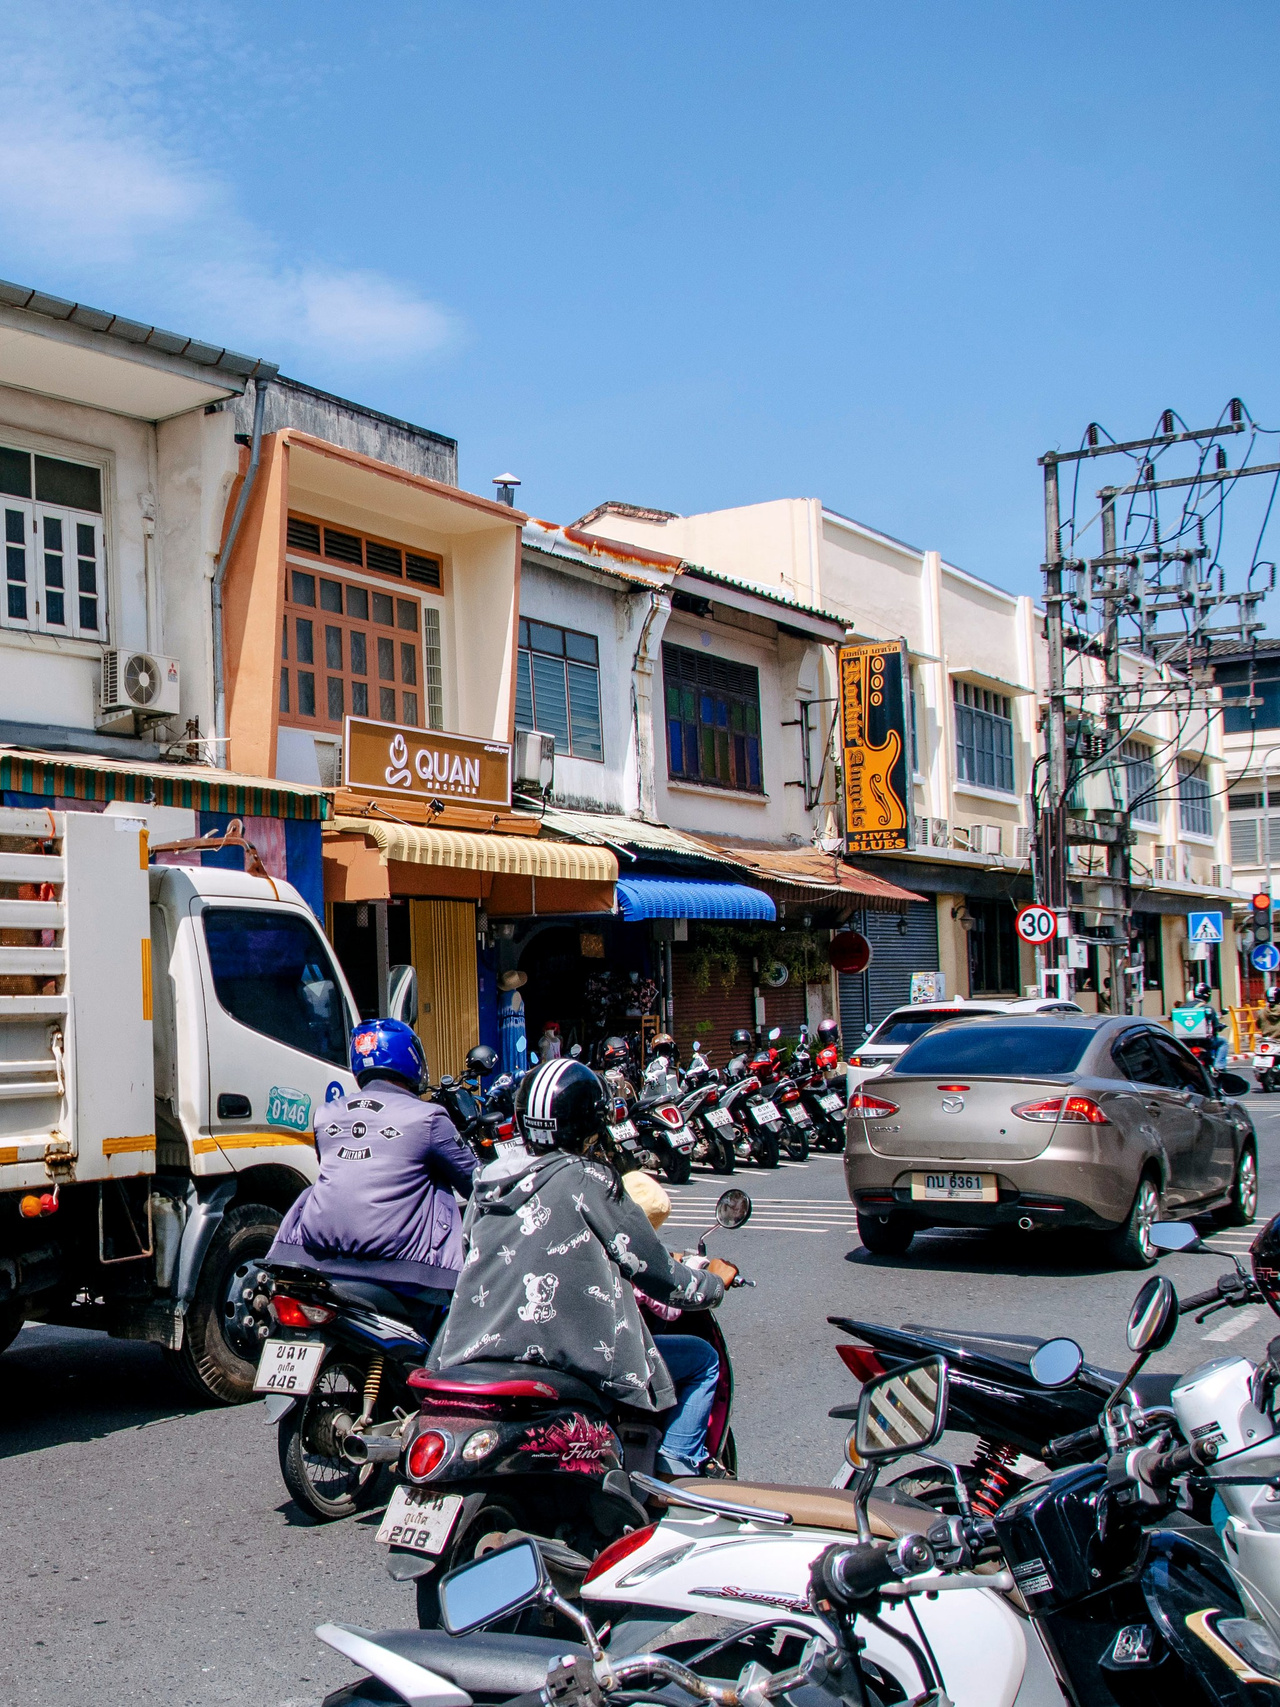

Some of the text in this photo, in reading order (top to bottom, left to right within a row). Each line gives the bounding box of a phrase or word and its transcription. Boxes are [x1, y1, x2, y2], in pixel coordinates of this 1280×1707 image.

[415, 749, 480, 787] QUAN
[427, 781, 477, 795] MASSAGE
[848, 838, 906, 852] BLUES
[862, 832, 891, 841] LIVE
[1021, 912, 1051, 937] 30
[272, 1099, 306, 1126] 0146
[949, 1176, 981, 1189] 6361
[266, 1374, 297, 1389] 446
[561, 1441, 606, 1461] Fino
[388, 1525, 431, 1548] 208
